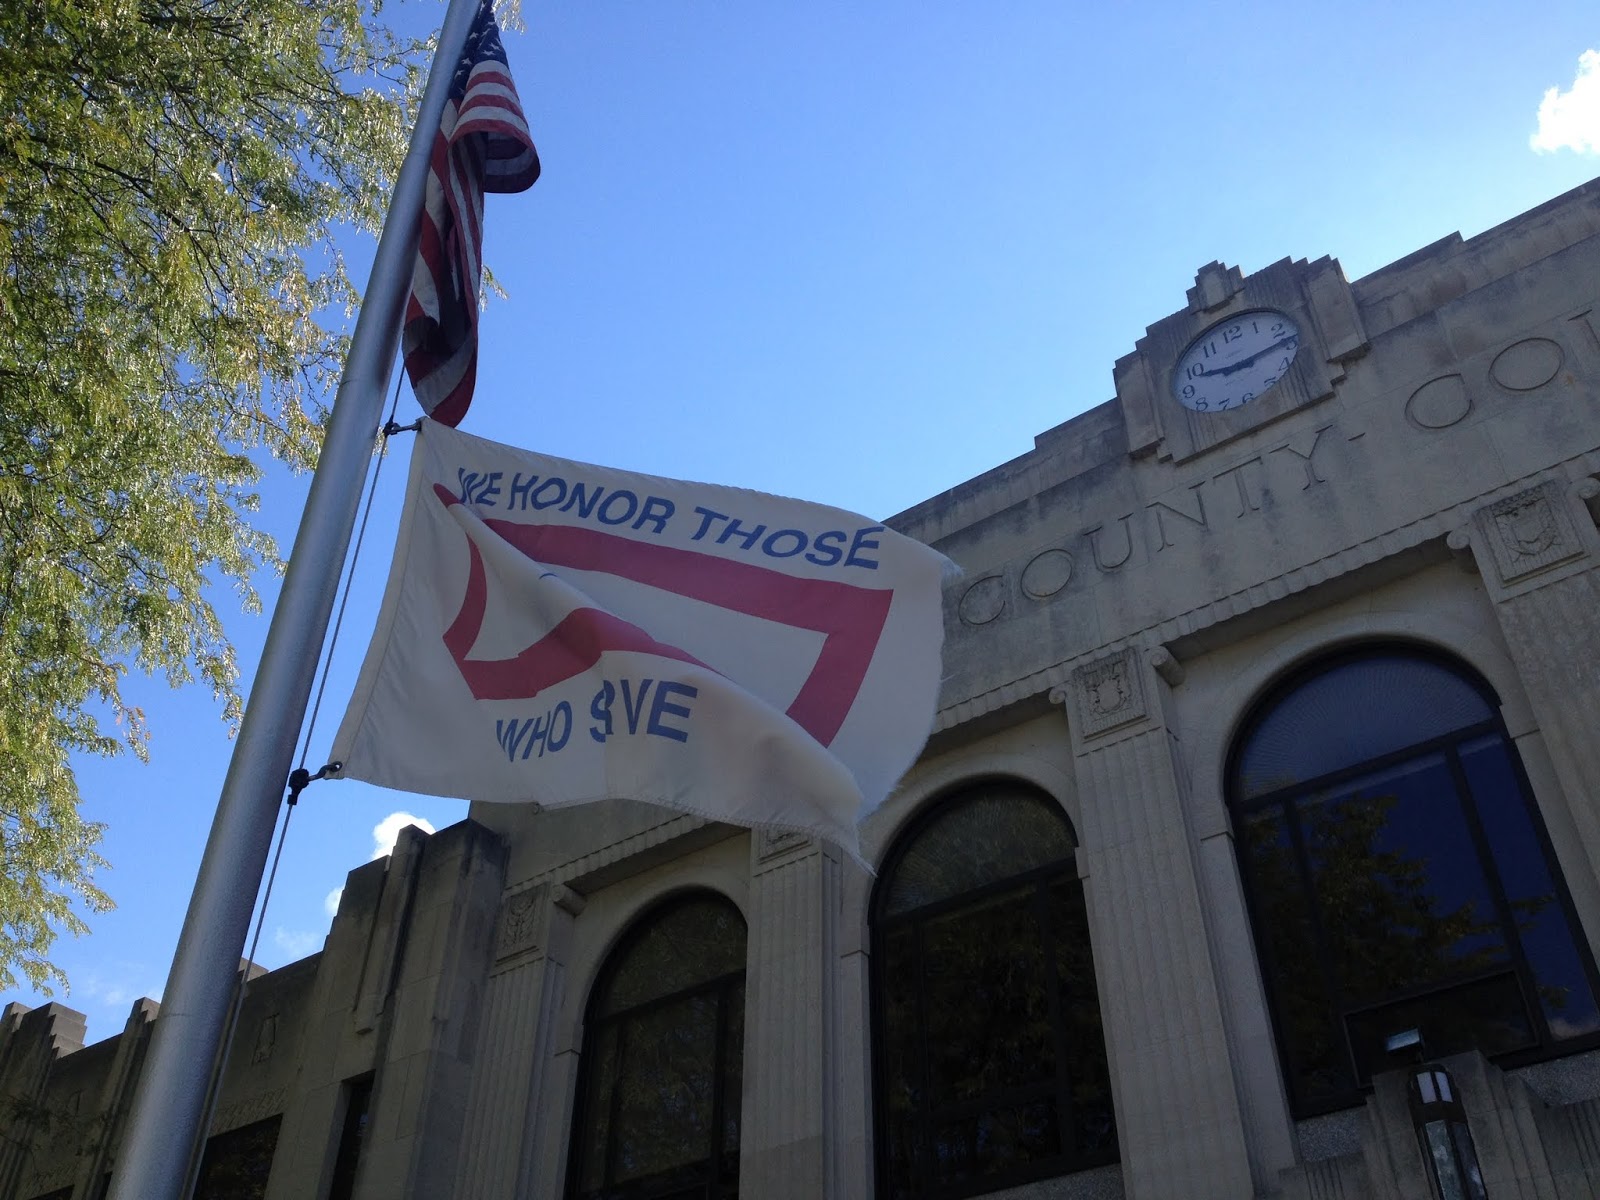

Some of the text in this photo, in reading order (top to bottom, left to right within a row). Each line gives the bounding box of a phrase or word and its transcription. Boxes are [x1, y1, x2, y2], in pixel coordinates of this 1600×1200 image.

[1223, 325, 1243, 344] 12
[1252, 321, 1260, 334] 1
[1271, 322, 1286, 339] 2
[1203, 341, 1217, 358] 11
[1186, 363, 1204, 380] 10
[1278, 357, 1290, 371] 4
[1404, 309, 1600, 432] CO
[1183, 385, 1195, 398] 9
[1196, 397, 1209, 411] 8
[1219, 398, 1230, 411] 7
[457, 467, 886, 570] WE HONOR THOSE
[496, 700, 573, 764] WHO
